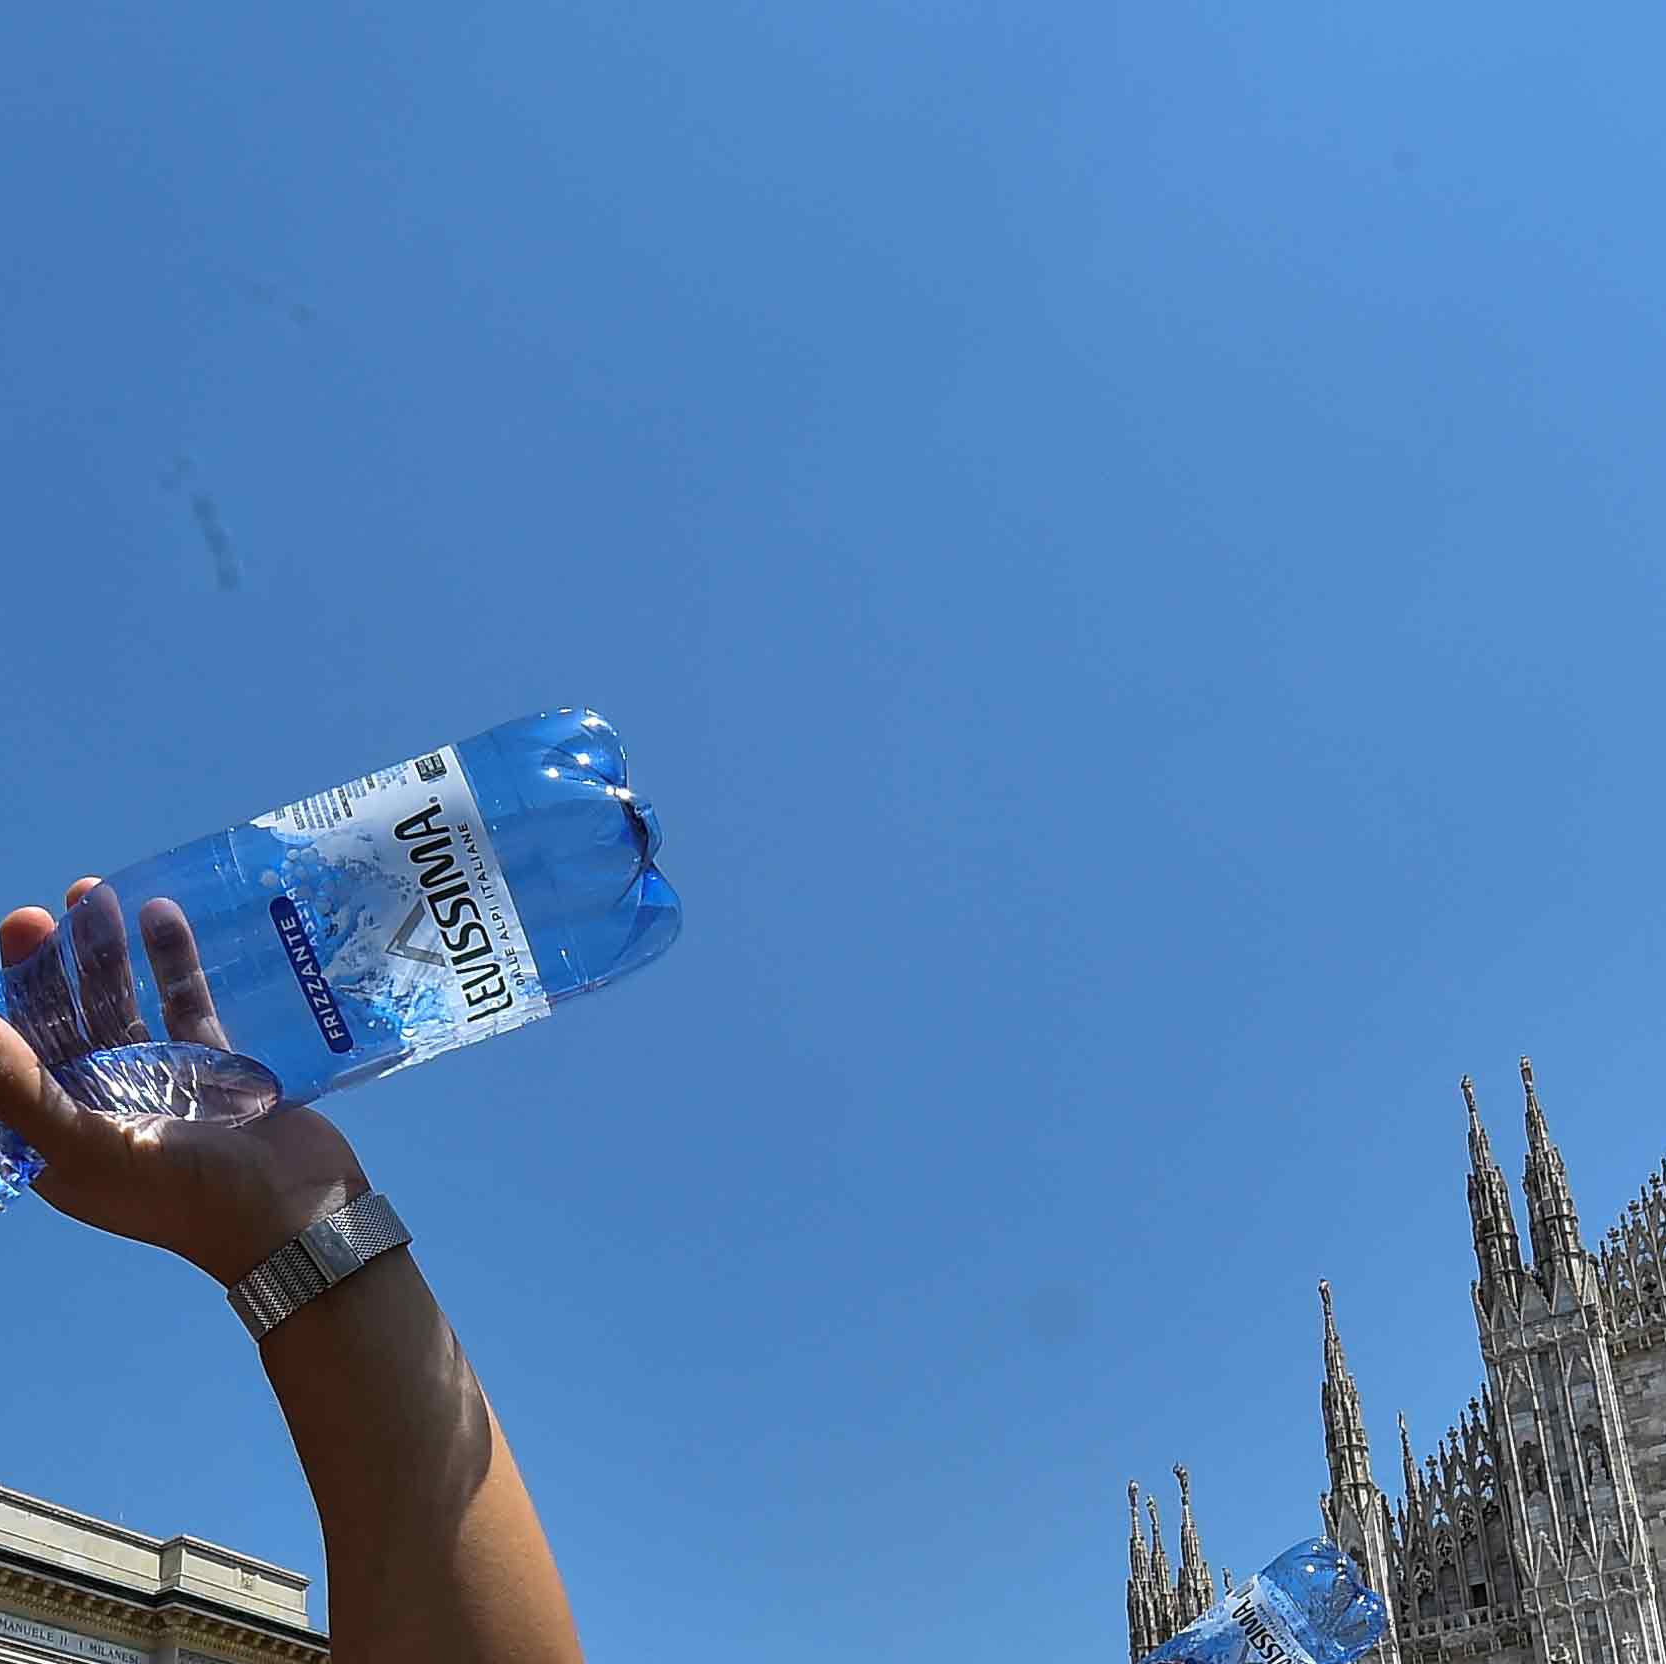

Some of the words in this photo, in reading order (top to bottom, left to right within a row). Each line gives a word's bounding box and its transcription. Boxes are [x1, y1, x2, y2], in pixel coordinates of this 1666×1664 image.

[457, 822, 495, 900] ITALIANE
[393, 803, 514, 1023] LEVISSIMA
[489, 906, 510, 941] ALPI
[280, 916, 346, 1040] FRIZZANTE
[504, 946, 526, 986] DALLE
